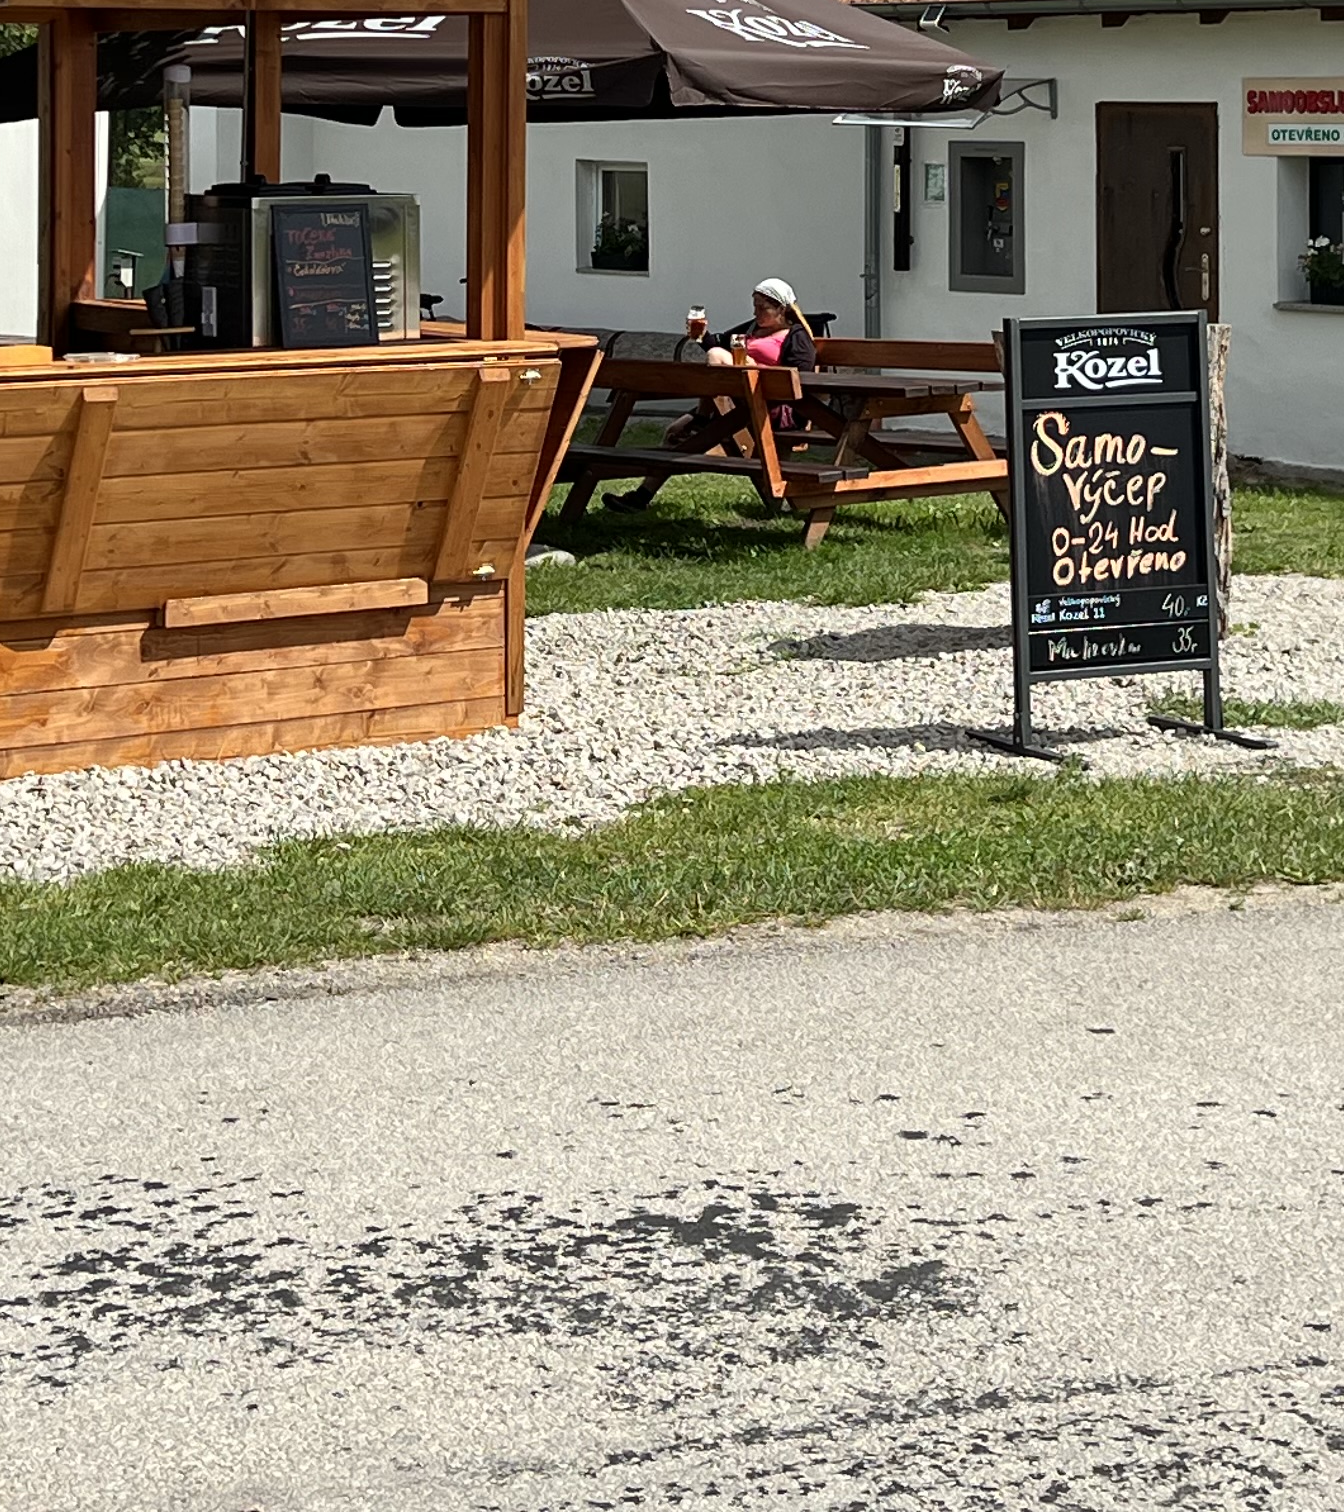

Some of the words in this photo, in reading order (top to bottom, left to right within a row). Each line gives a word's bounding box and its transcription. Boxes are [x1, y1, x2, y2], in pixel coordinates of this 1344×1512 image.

[526, 61, 596, 100] ozel
[1271, 126, 1340, 141] OTEVŘENO
[1053, 348, 1163, 390] Kozel
[1129, 508, 1180, 546] Hod
[1052, 548, 1187, 586] Otevřeno
[1059, 608, 1089, 621] Kozel
